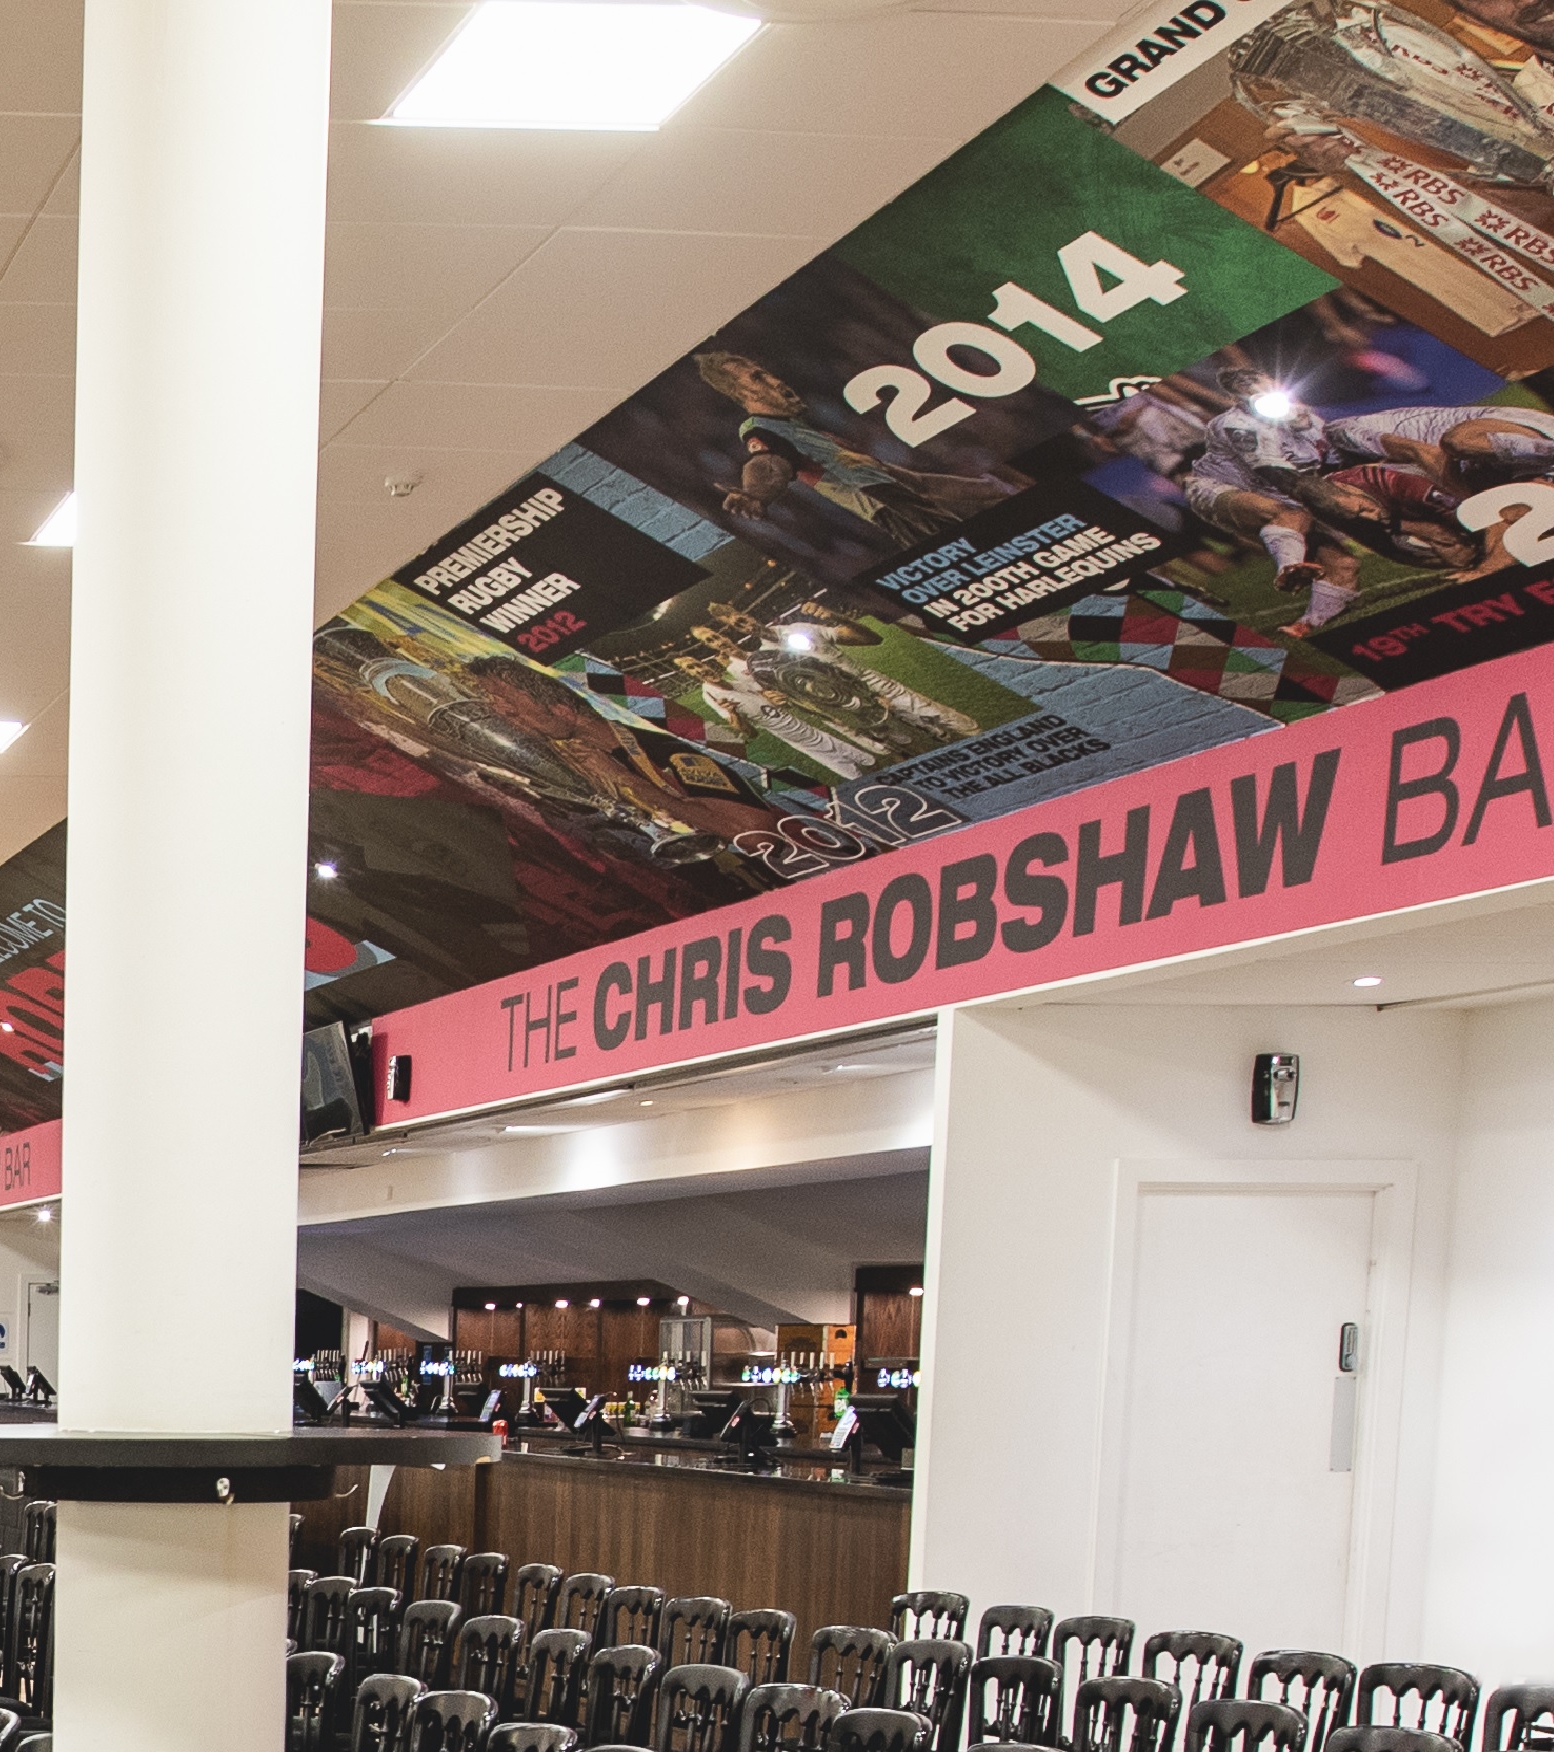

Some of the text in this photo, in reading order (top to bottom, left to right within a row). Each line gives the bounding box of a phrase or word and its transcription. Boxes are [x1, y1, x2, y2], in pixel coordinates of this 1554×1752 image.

[1084, 0, 1228, 100] GRAND
[1393, 188, 1449, 228] RBS
[1403, 169, 1465, 205] RBS
[1480, 253, 1539, 291] RBS
[843, 230, 1189, 448] 2014
[413, 486, 565, 596] PREMIERSHIP
[877, 536, 977, 591] VICTORY
[900, 512, 1089, 605] OVER LEINSTER
[922, 525, 1118, 619] IN 200TH GAME
[448, 556, 533, 614] RUGBY
[479, 572, 581, 635] WINNER
[947, 531, 1163, 633] FOR HARLEQUINS
[1432, 590, 1526, 636] TRY
[517, 610, 589, 654] 2012
[875, 714, 1068, 788] CAPTAINS ENGLAND
[912, 726, 1094, 791] TO VICTORY OVER
[942, 738, 1112, 800] THE ALL BLACKS
[733, 785, 963, 880] 2012
[500, 976, 580, 1072] THE
[593, 912, 793, 1051] CHRIS
[817, 748, 1341, 998] ROBSHAW
[4, 1141, 32, 1190] BAR
